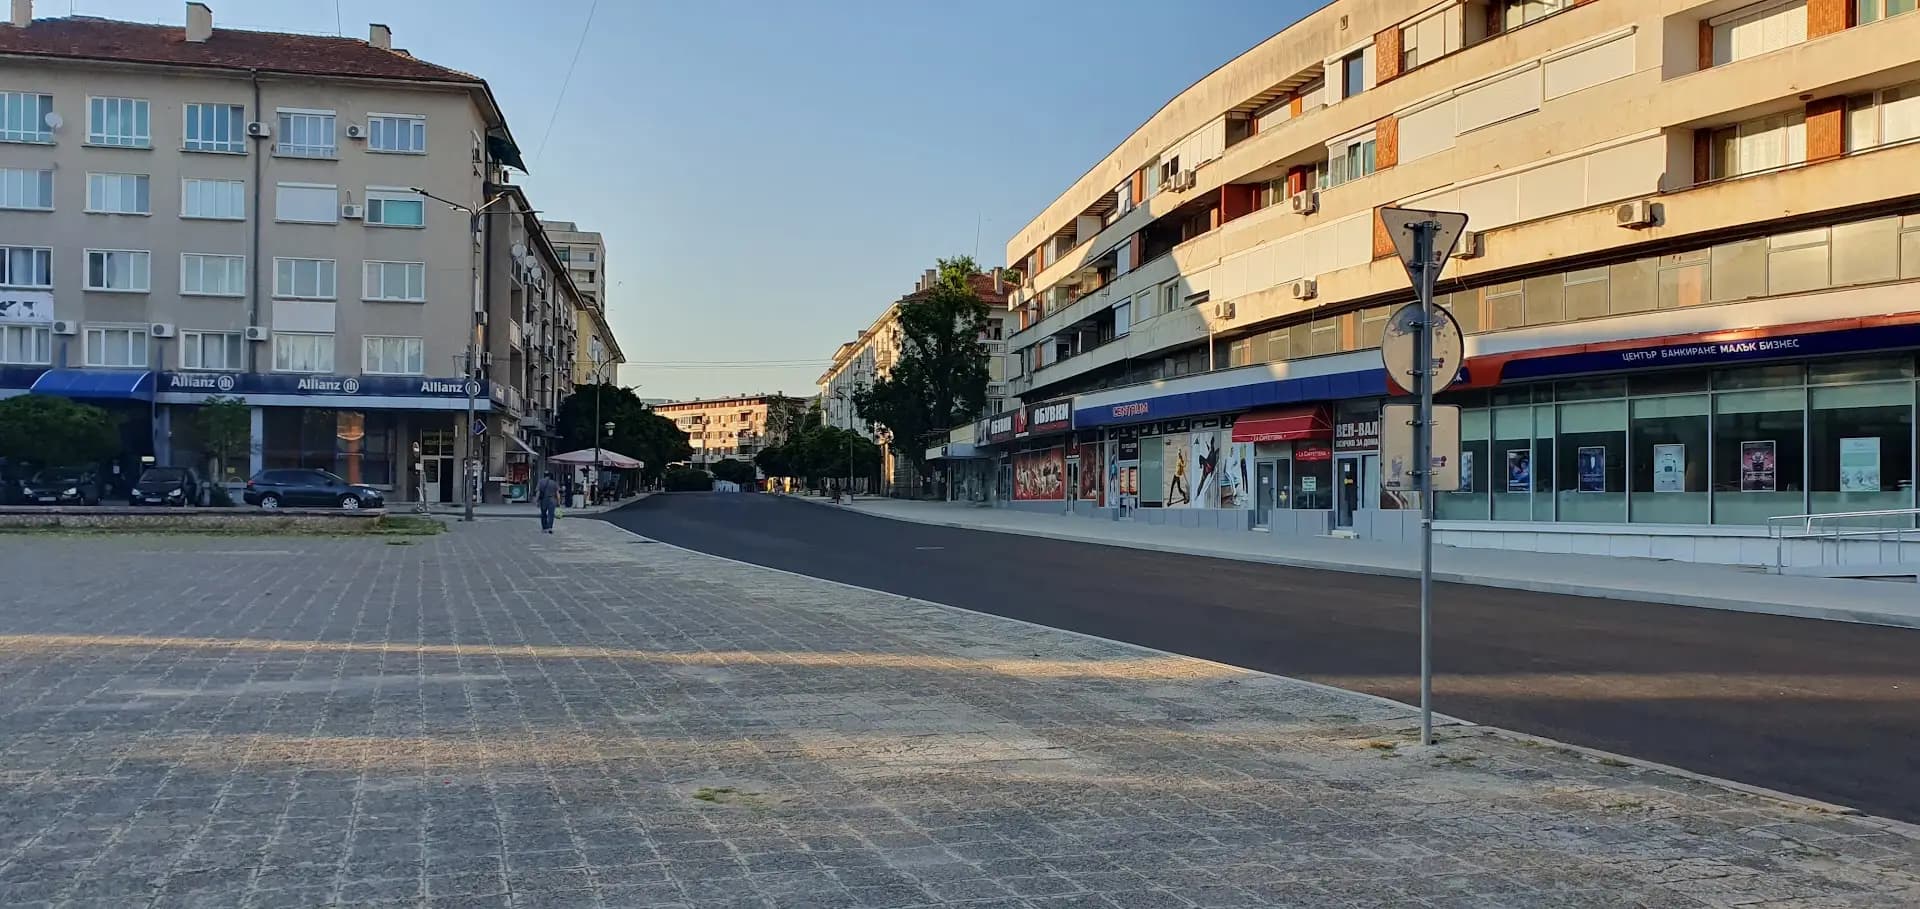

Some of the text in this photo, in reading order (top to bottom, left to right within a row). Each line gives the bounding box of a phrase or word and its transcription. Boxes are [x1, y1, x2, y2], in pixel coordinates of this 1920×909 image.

[1622, 338, 1800, 361] ЦЕНТЪР БАНКИРАНЕ МАЛЪК БИЗНЕС
[171, 375, 215, 388] Allianz
[297, 378, 341, 391] Allianz
[420, 381, 463, 394] Allianz
[1034, 403, 1069, 425] ОБУВКИ
[1113, 402, 1149, 418] CENTRUM
